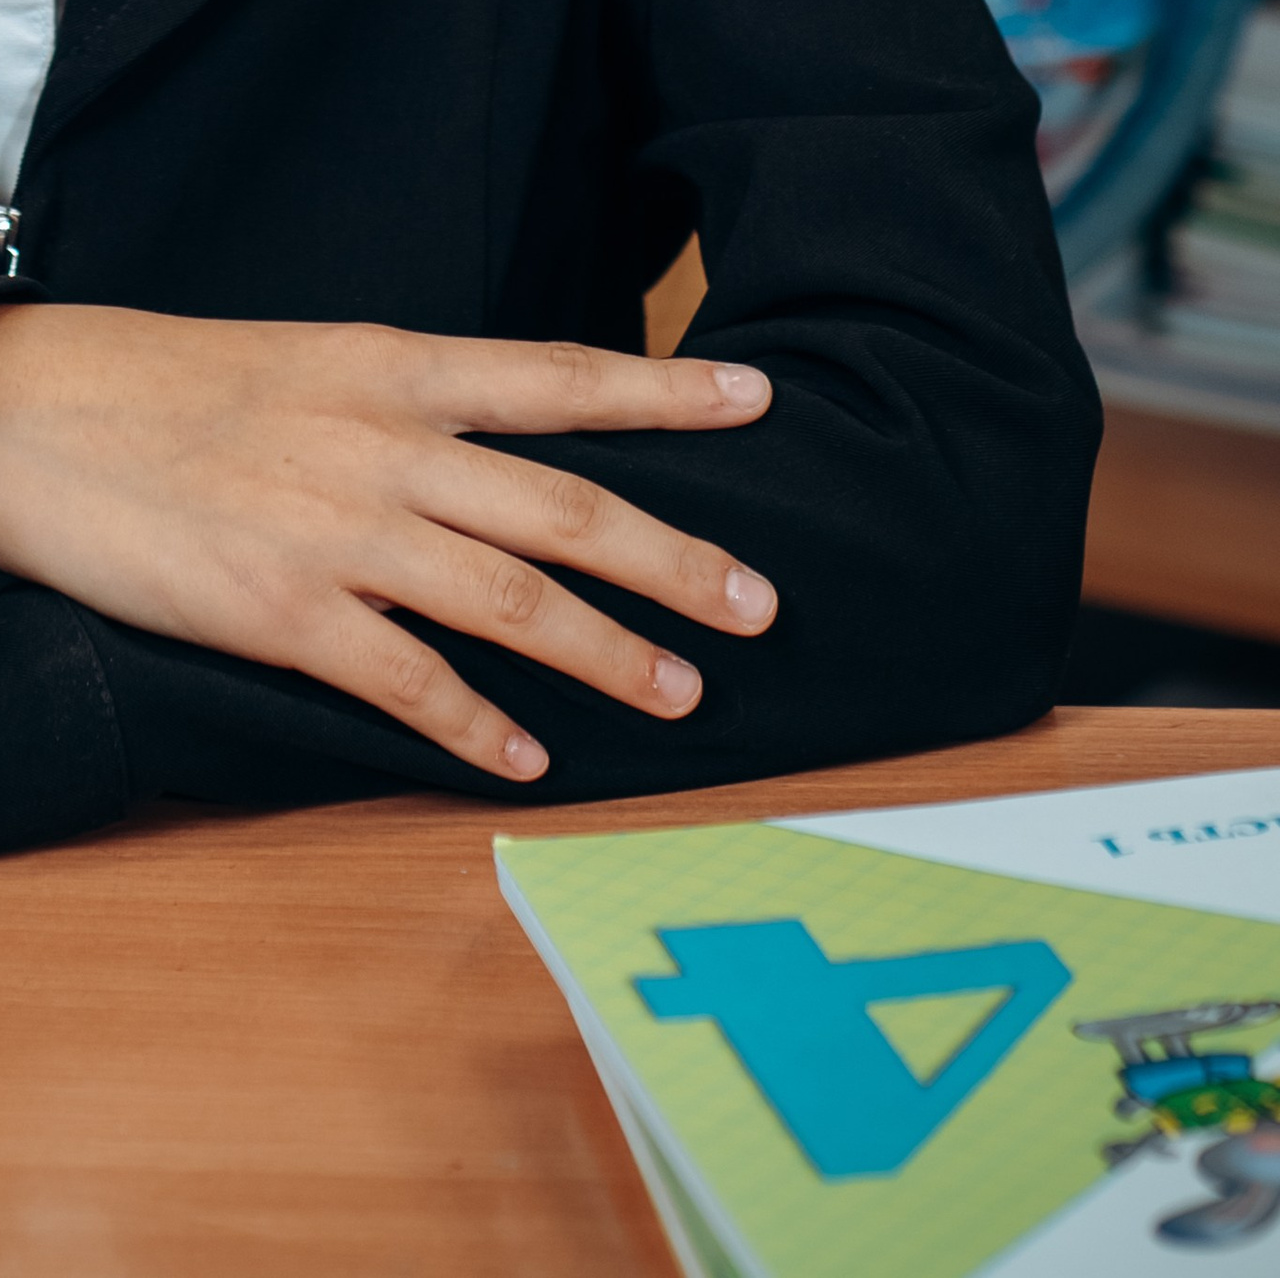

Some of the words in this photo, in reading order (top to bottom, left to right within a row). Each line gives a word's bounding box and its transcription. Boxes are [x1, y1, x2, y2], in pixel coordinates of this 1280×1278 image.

[1147, 814, 1280, 846] сть
[1091, 835, 1134, 860] 1
[630, 917, 1074, 1185] 4
